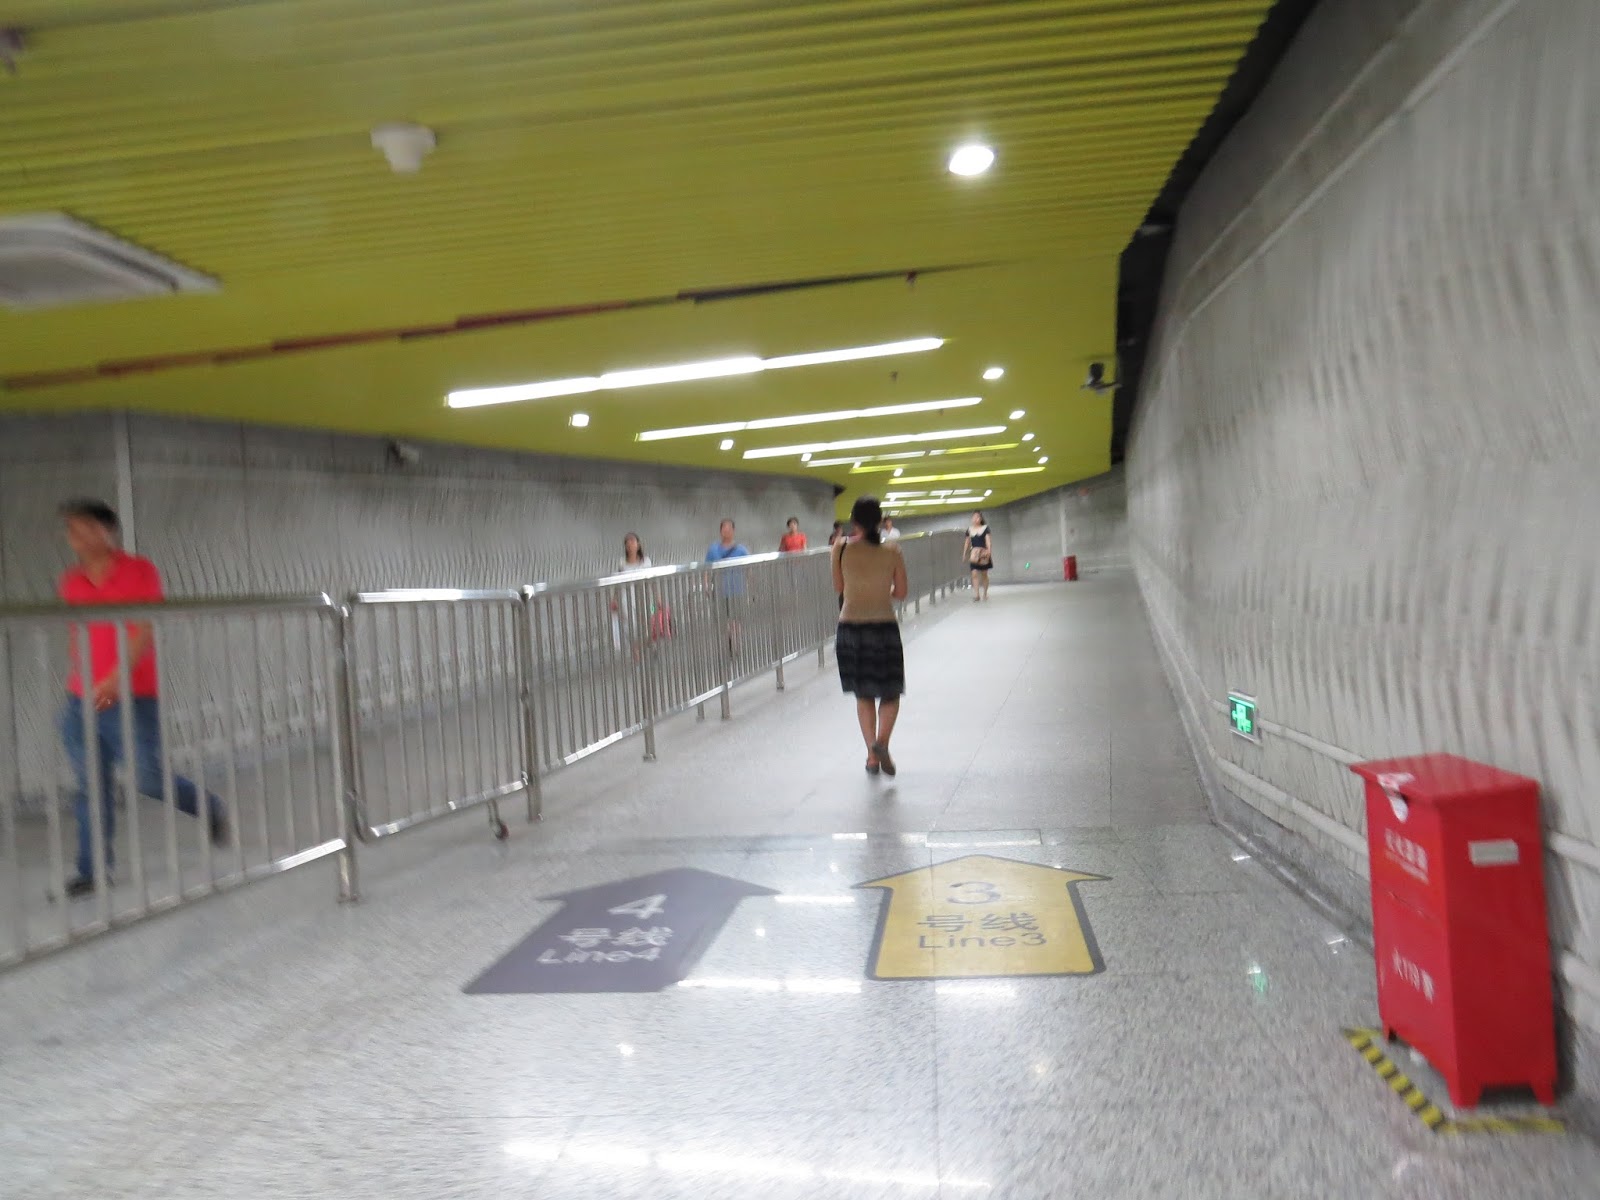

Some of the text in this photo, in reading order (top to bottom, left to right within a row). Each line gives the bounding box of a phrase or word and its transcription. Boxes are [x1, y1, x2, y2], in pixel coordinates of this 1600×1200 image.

[946, 881, 1002, 905] 3
[607, 893, 668, 920] 4
[916, 912, 1039, 932] 号线
[919, 932, 1047, 949] Line3
